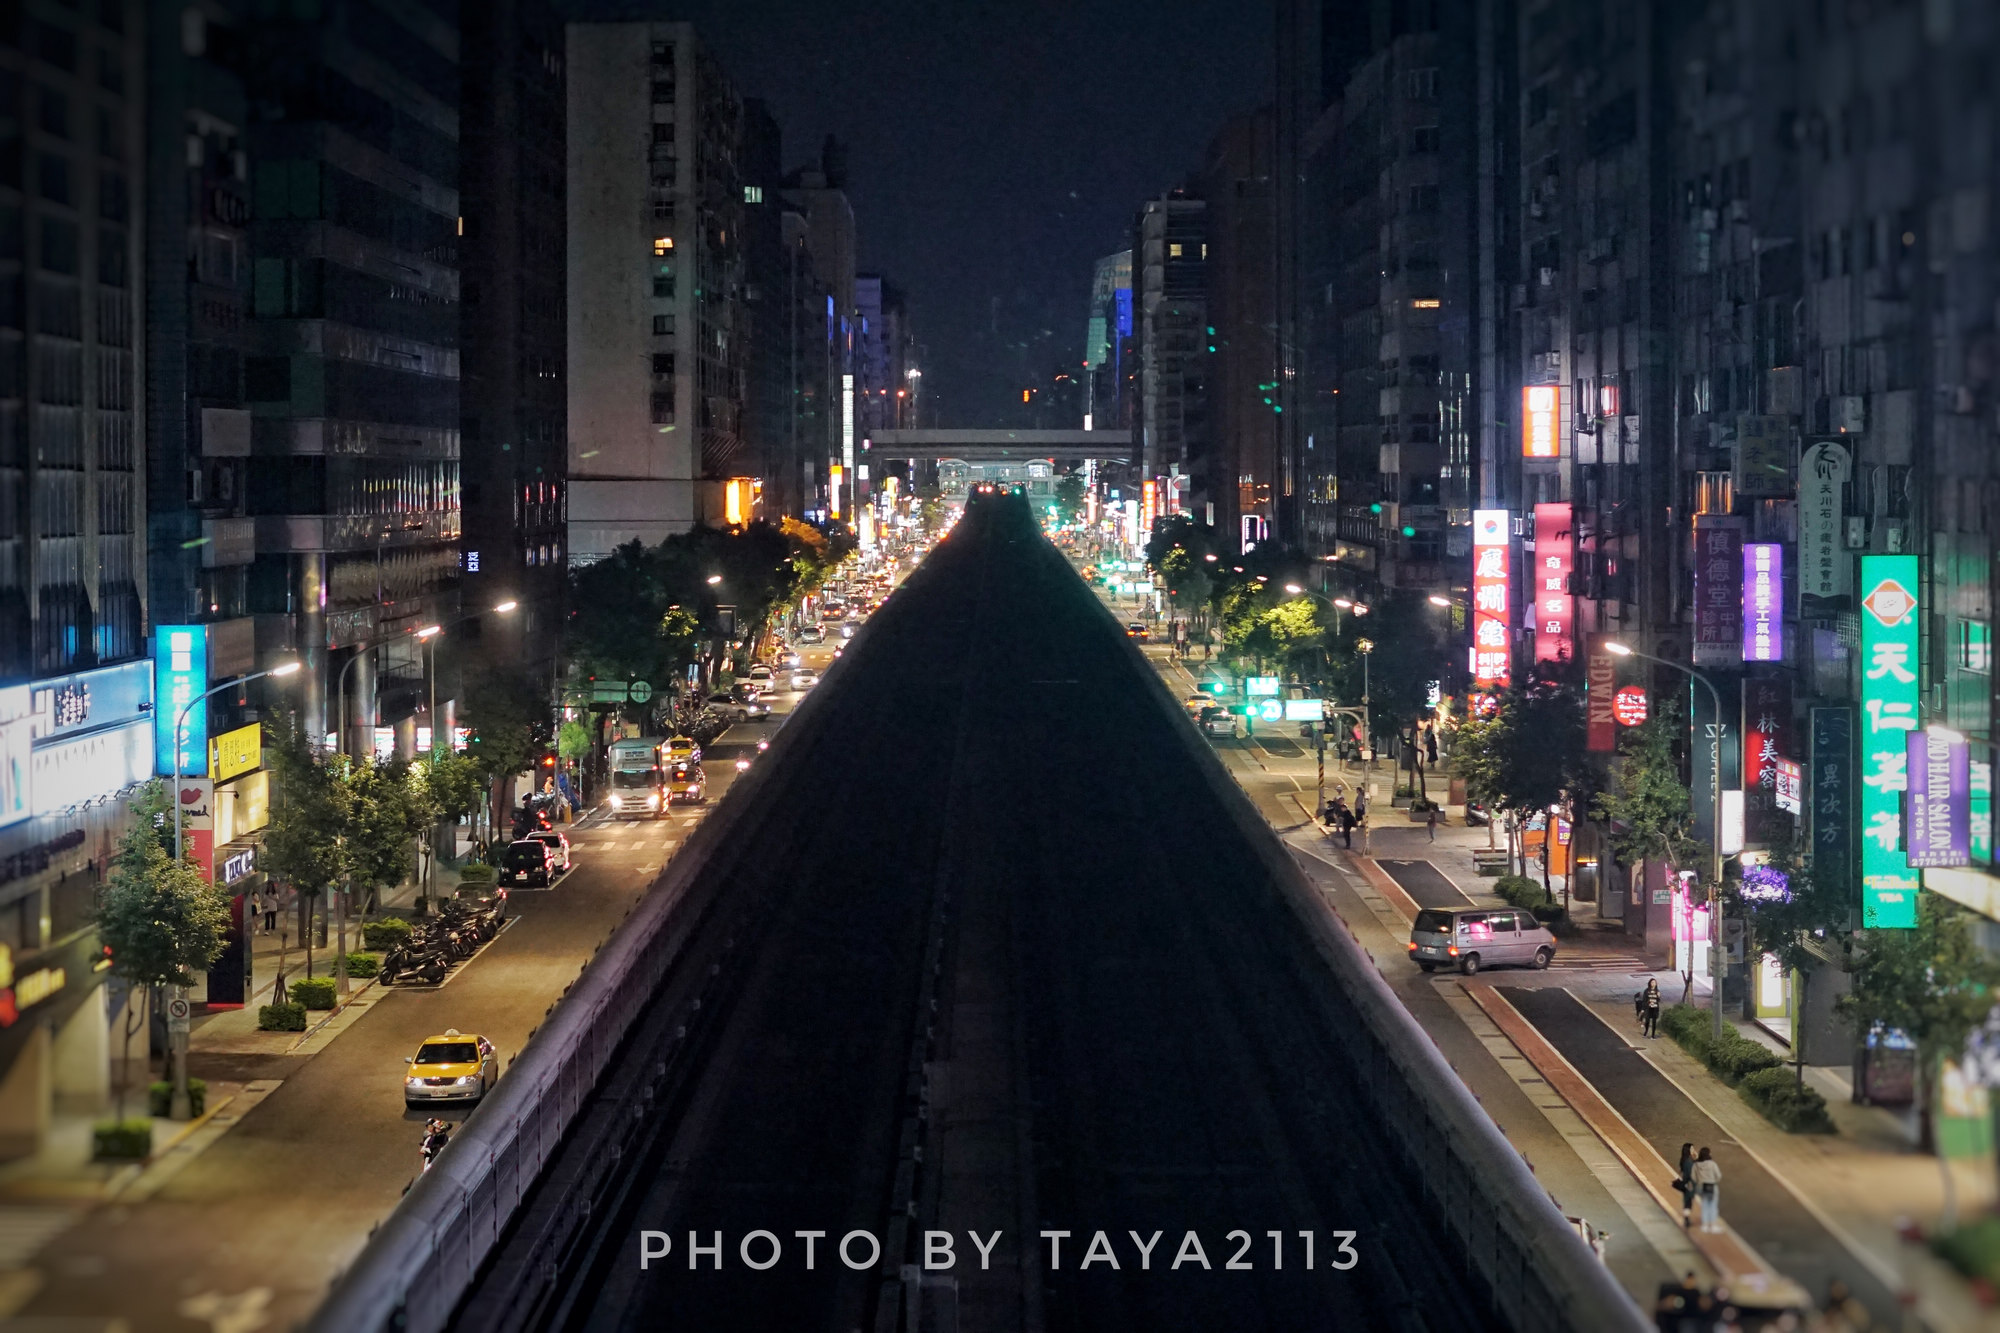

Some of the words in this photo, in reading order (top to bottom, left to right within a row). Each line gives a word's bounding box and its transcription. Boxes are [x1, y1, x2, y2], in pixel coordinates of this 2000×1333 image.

[1545, 556, 1562, 634] 奇威名品
[1706, 531, 1731, 608] 慎德堂
[1590, 655, 1614, 723] EDWIN
[1757, 686, 1780, 789] 紅林美容
[1818, 763, 1842, 844] 異次方
[1928, 762, 1951, 800] HAIR
[1929, 804, 1952, 850] SALON
